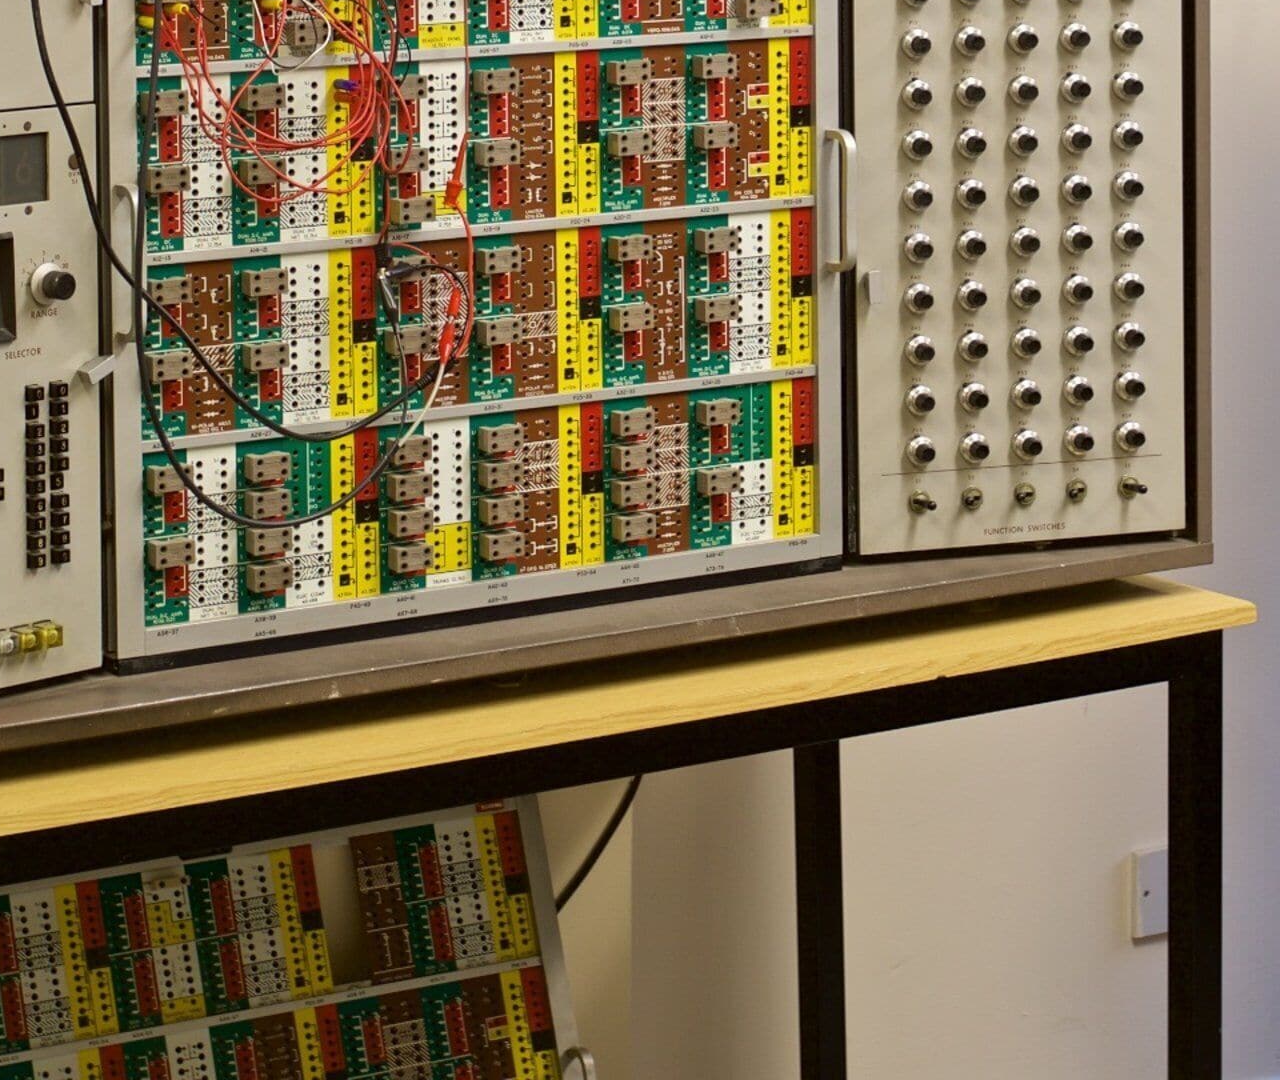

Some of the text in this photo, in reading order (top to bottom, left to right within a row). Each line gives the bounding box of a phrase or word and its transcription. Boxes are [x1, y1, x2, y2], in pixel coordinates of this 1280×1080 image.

[30, 308, 58, 319] RANGE
[5, 347, 41, 360] SELECTOR
[983, 522, 1066, 536] FUNCTION SWITCHES
